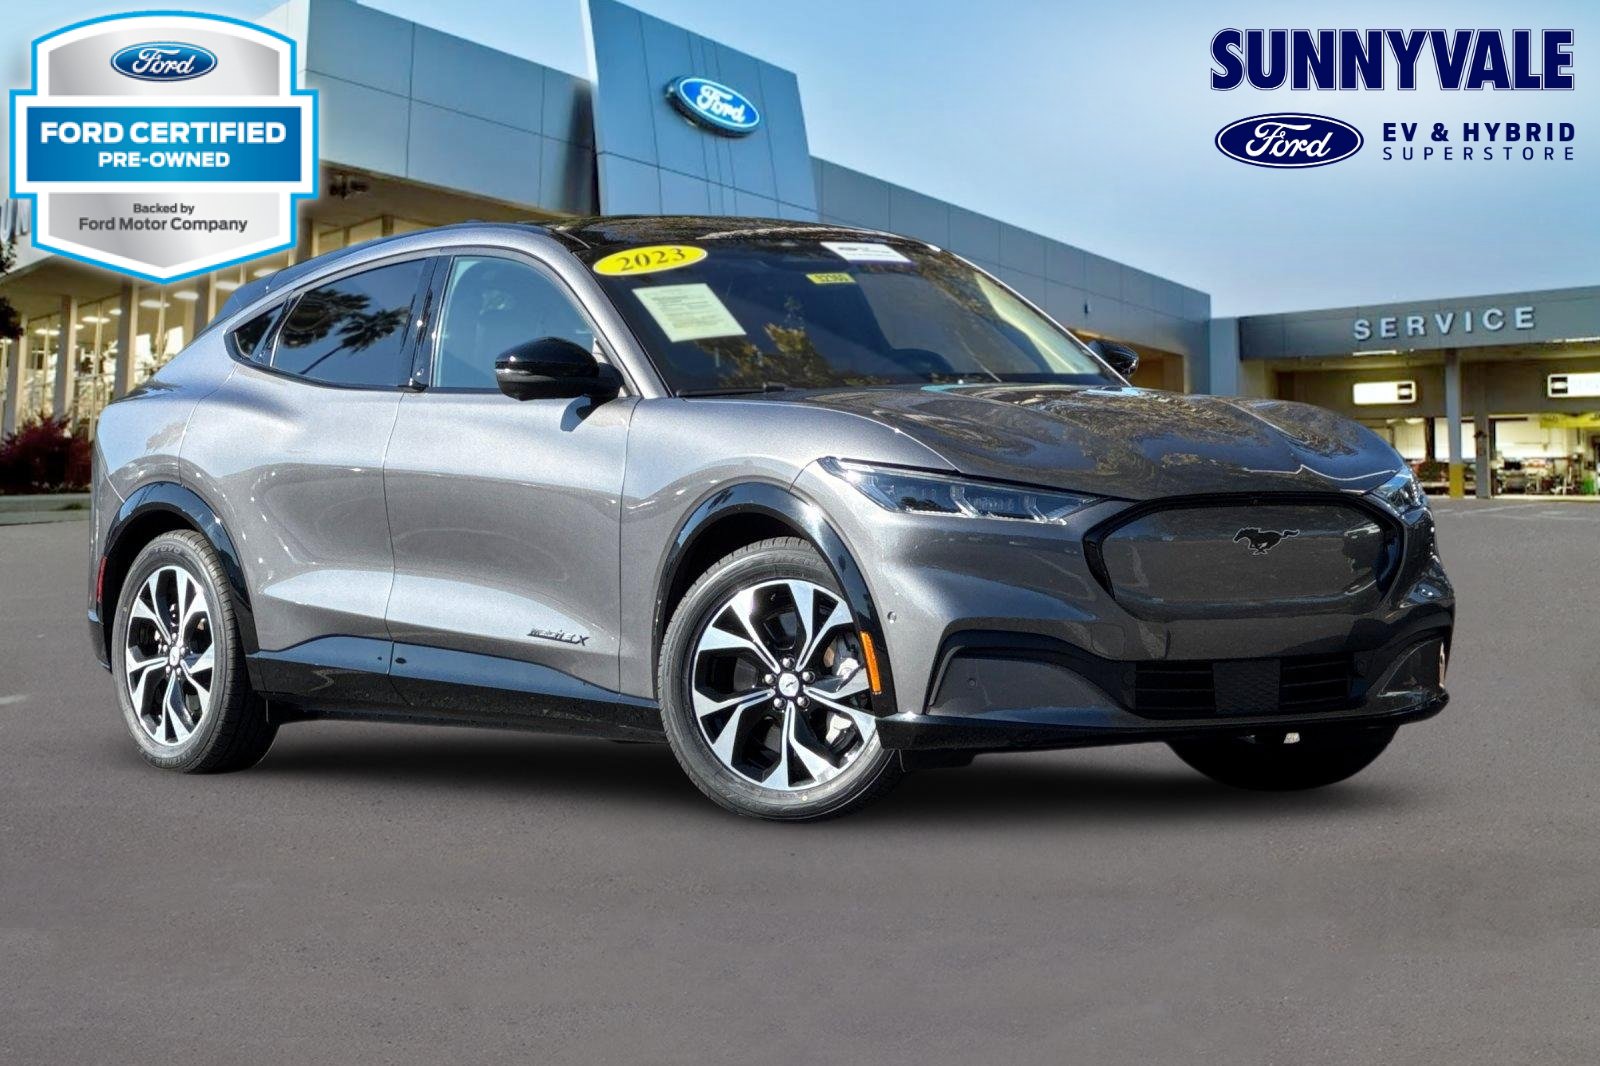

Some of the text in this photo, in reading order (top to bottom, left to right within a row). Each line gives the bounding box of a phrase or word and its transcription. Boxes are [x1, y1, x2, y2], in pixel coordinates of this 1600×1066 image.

[696, 84, 746, 123] Ford
[616, 247, 685, 271] 2023
[1353, 305, 1535, 341] SERVICE
